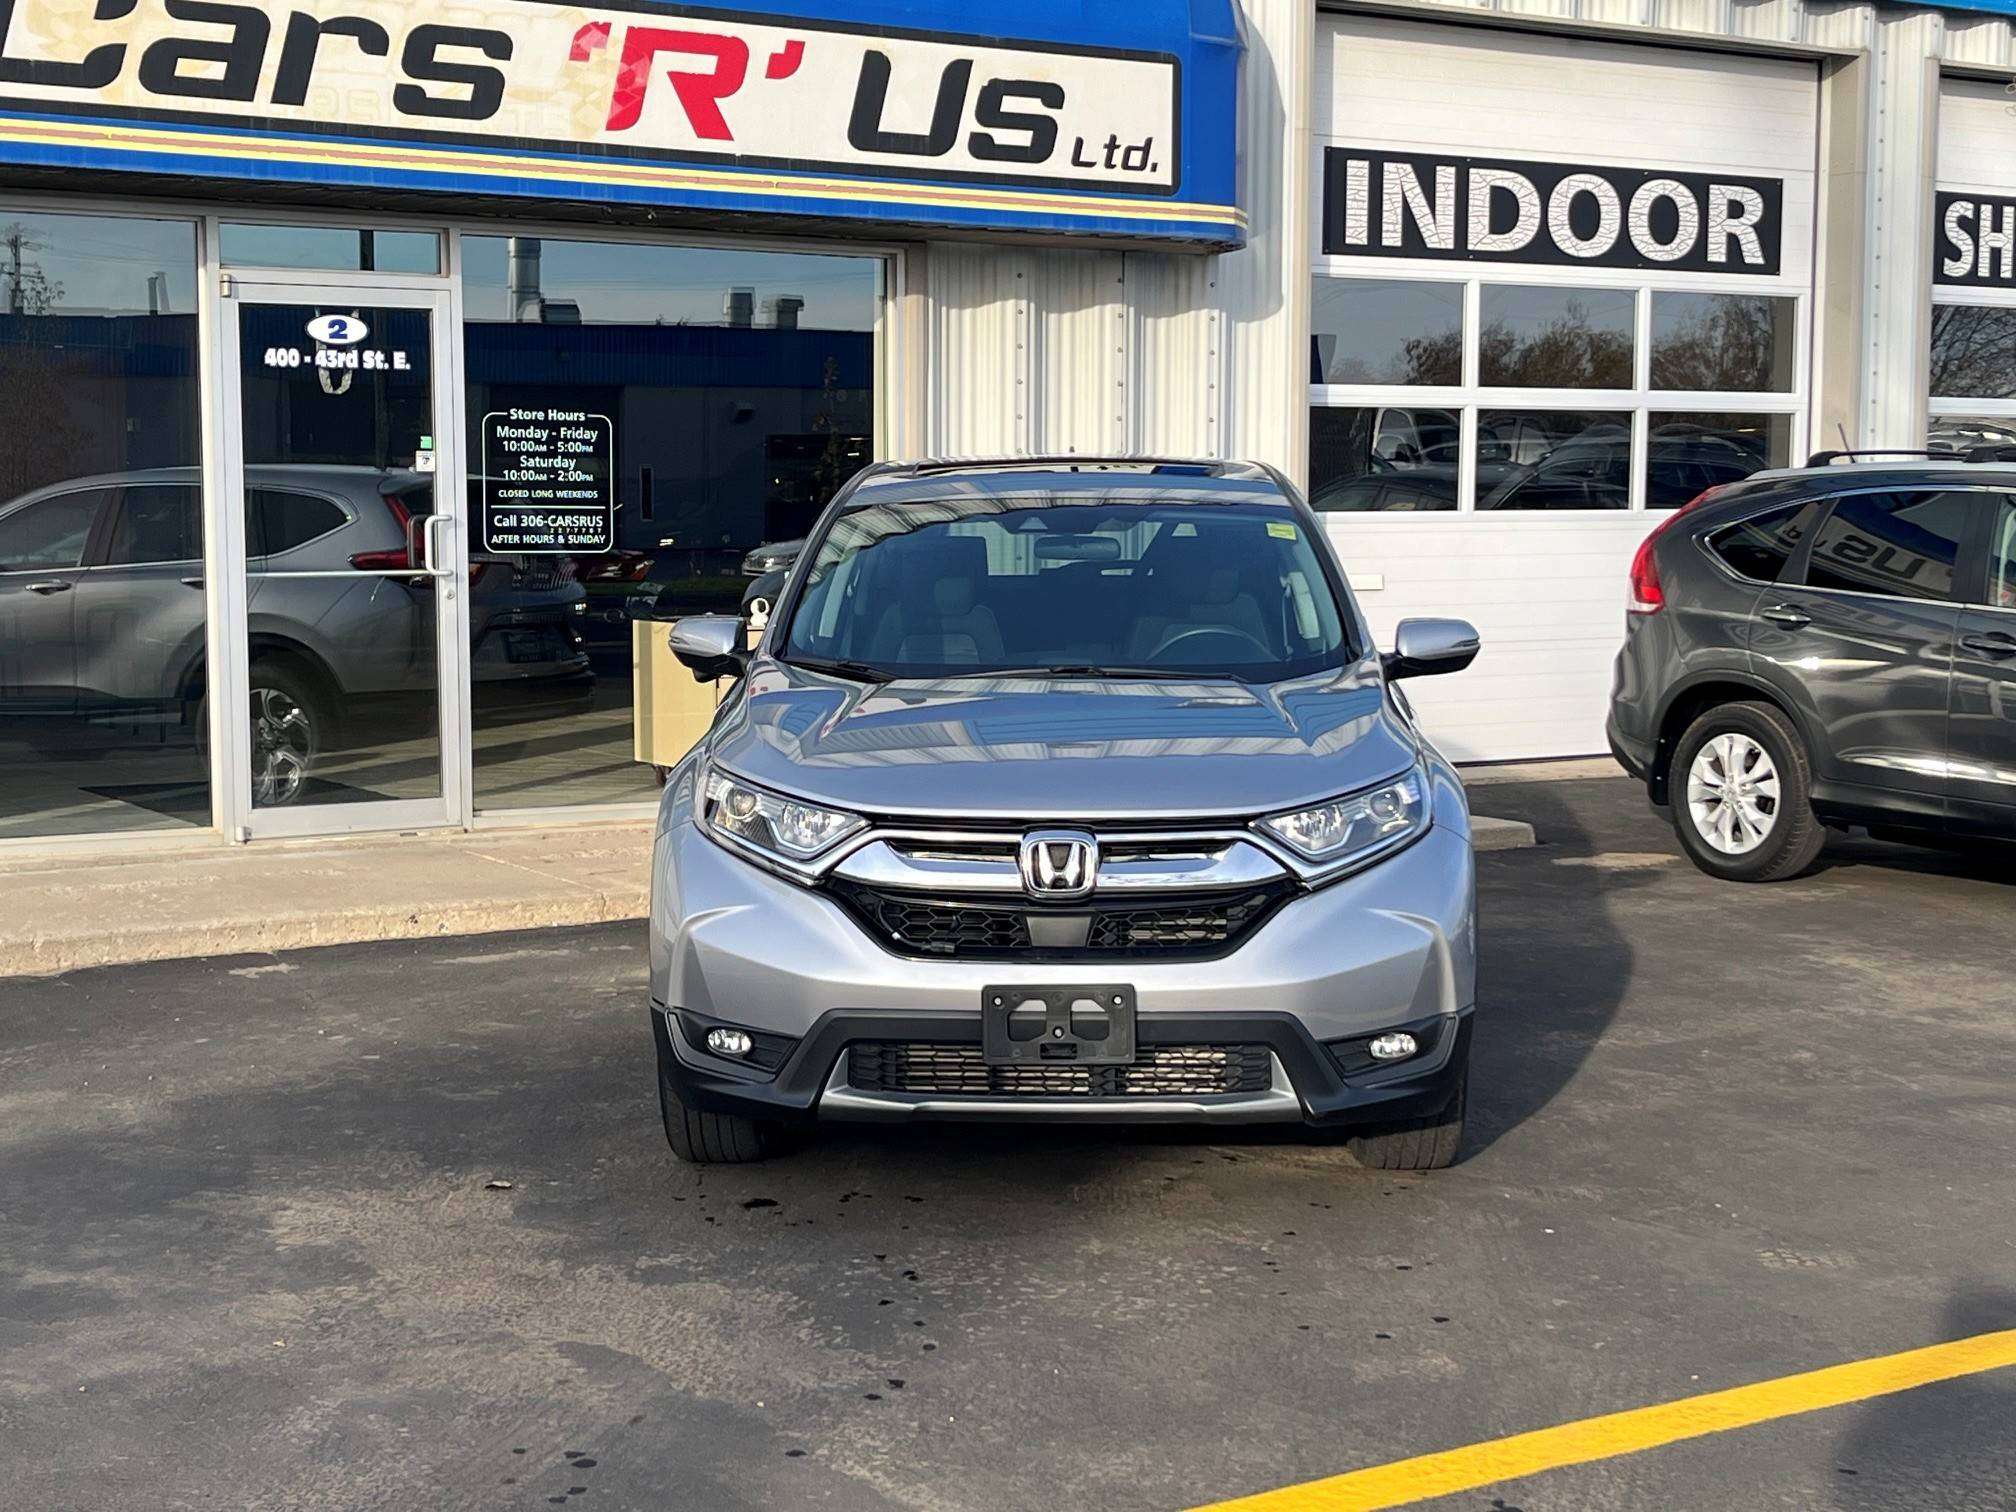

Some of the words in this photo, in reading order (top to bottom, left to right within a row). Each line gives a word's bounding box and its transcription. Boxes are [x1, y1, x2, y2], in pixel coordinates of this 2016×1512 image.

[0, 0, 512, 120] Cars
[1071, 133, 1158, 173] Ltd.
[1343, 158, 1767, 267] INDOOR
[1942, 200, 2016, 279] SH
[327, 318, 348, 340] 2
[264, 347, 300, 368] 400
[315, 349, 358, 369] 43rd
[362, 350, 389, 370] St.
[393, 351, 411, 370] E.
[509, 408, 545, 421] Store
[547, 409, 586, 421] Hours
[496, 425, 549, 441] Monday
[560, 426, 598, 442] Friday
[502, 440, 547, 452] 10:00AM
[557, 441, 594, 453] 5:00PM
[520, 455, 577, 471] Saturday
[502, 469, 547, 481] 10:00AM
[557, 470, 594, 482] 2:00PM
[498, 489, 529, 498] CLOSED
[531, 489, 554, 498] LONG
[555, 490, 598, 499] WEEKENDS
[493, 514, 518, 527] Call
[520, 514, 603, 527] 306-CARSRUS
[490, 534, 521, 544] AFTER
[522, 534, 555, 544] HOURS
[557, 534, 565, 544] &
[567, 534, 606, 544] SUNDAY
